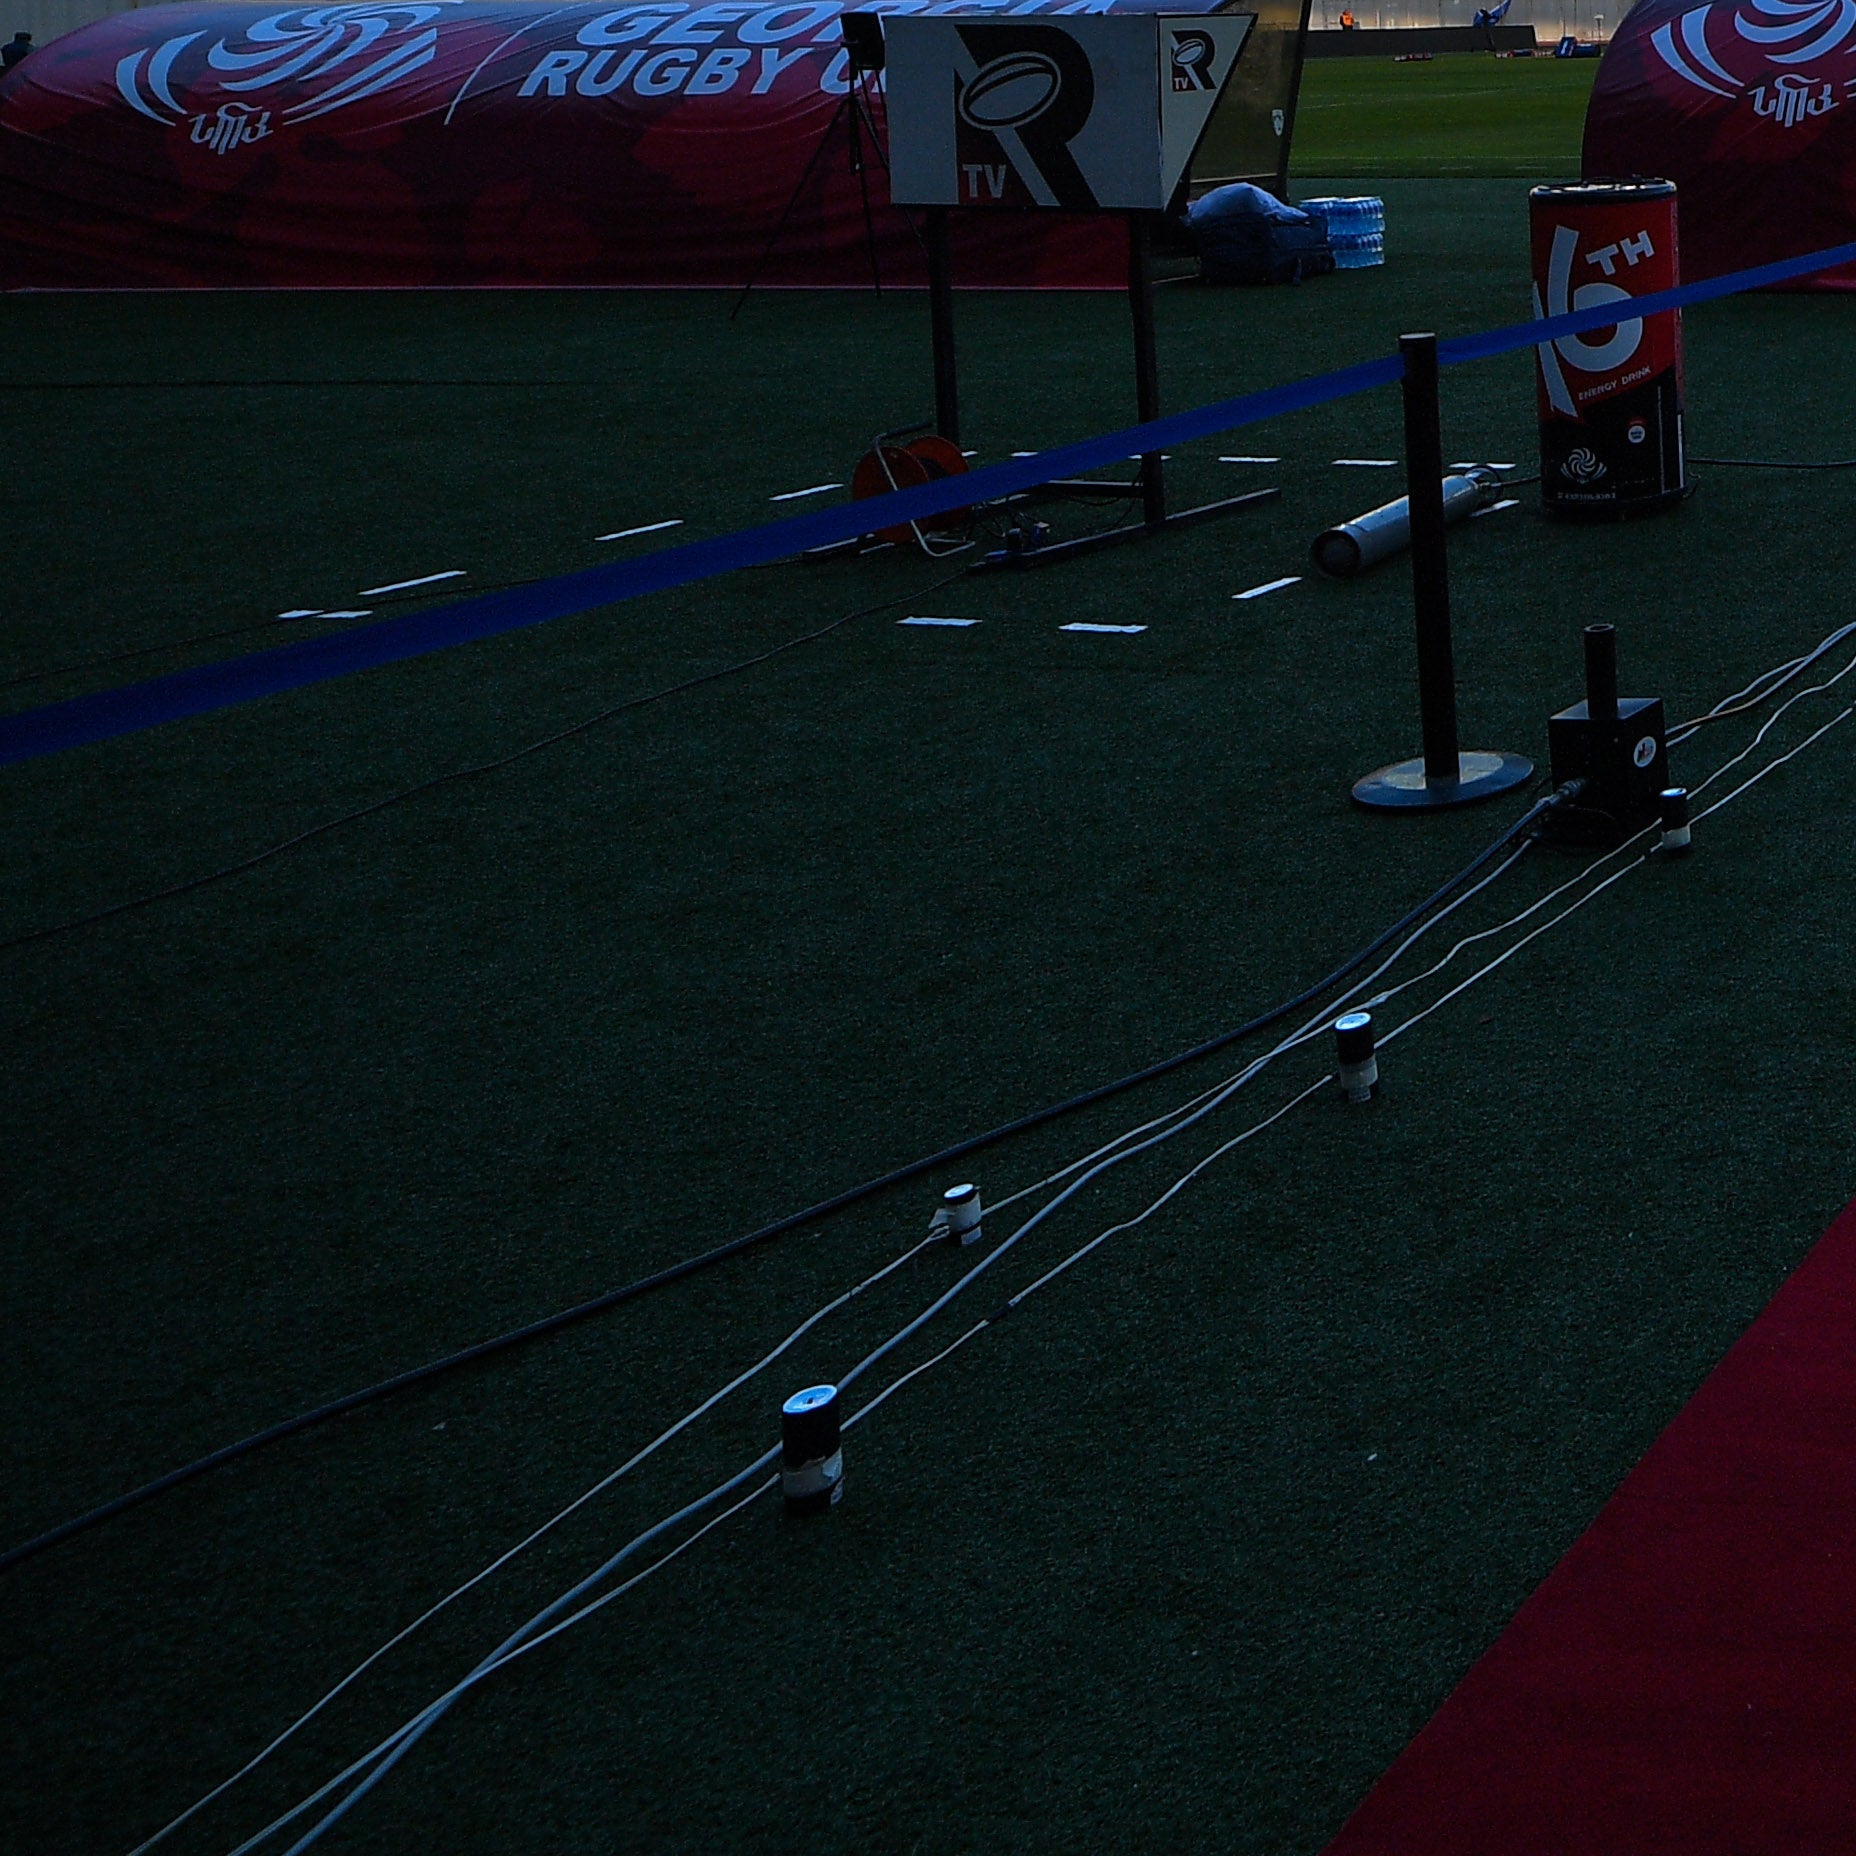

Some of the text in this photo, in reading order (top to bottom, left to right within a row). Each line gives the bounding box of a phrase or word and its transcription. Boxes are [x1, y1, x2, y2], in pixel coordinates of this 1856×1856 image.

[516, 47, 815, 98] RUGBY
[1173, 76, 1189, 91] TV
[964, 162, 1006, 199] TV
[1585, 229, 1656, 277] TH
[1577, 365, 1652, 401] ENERGY DRINK
